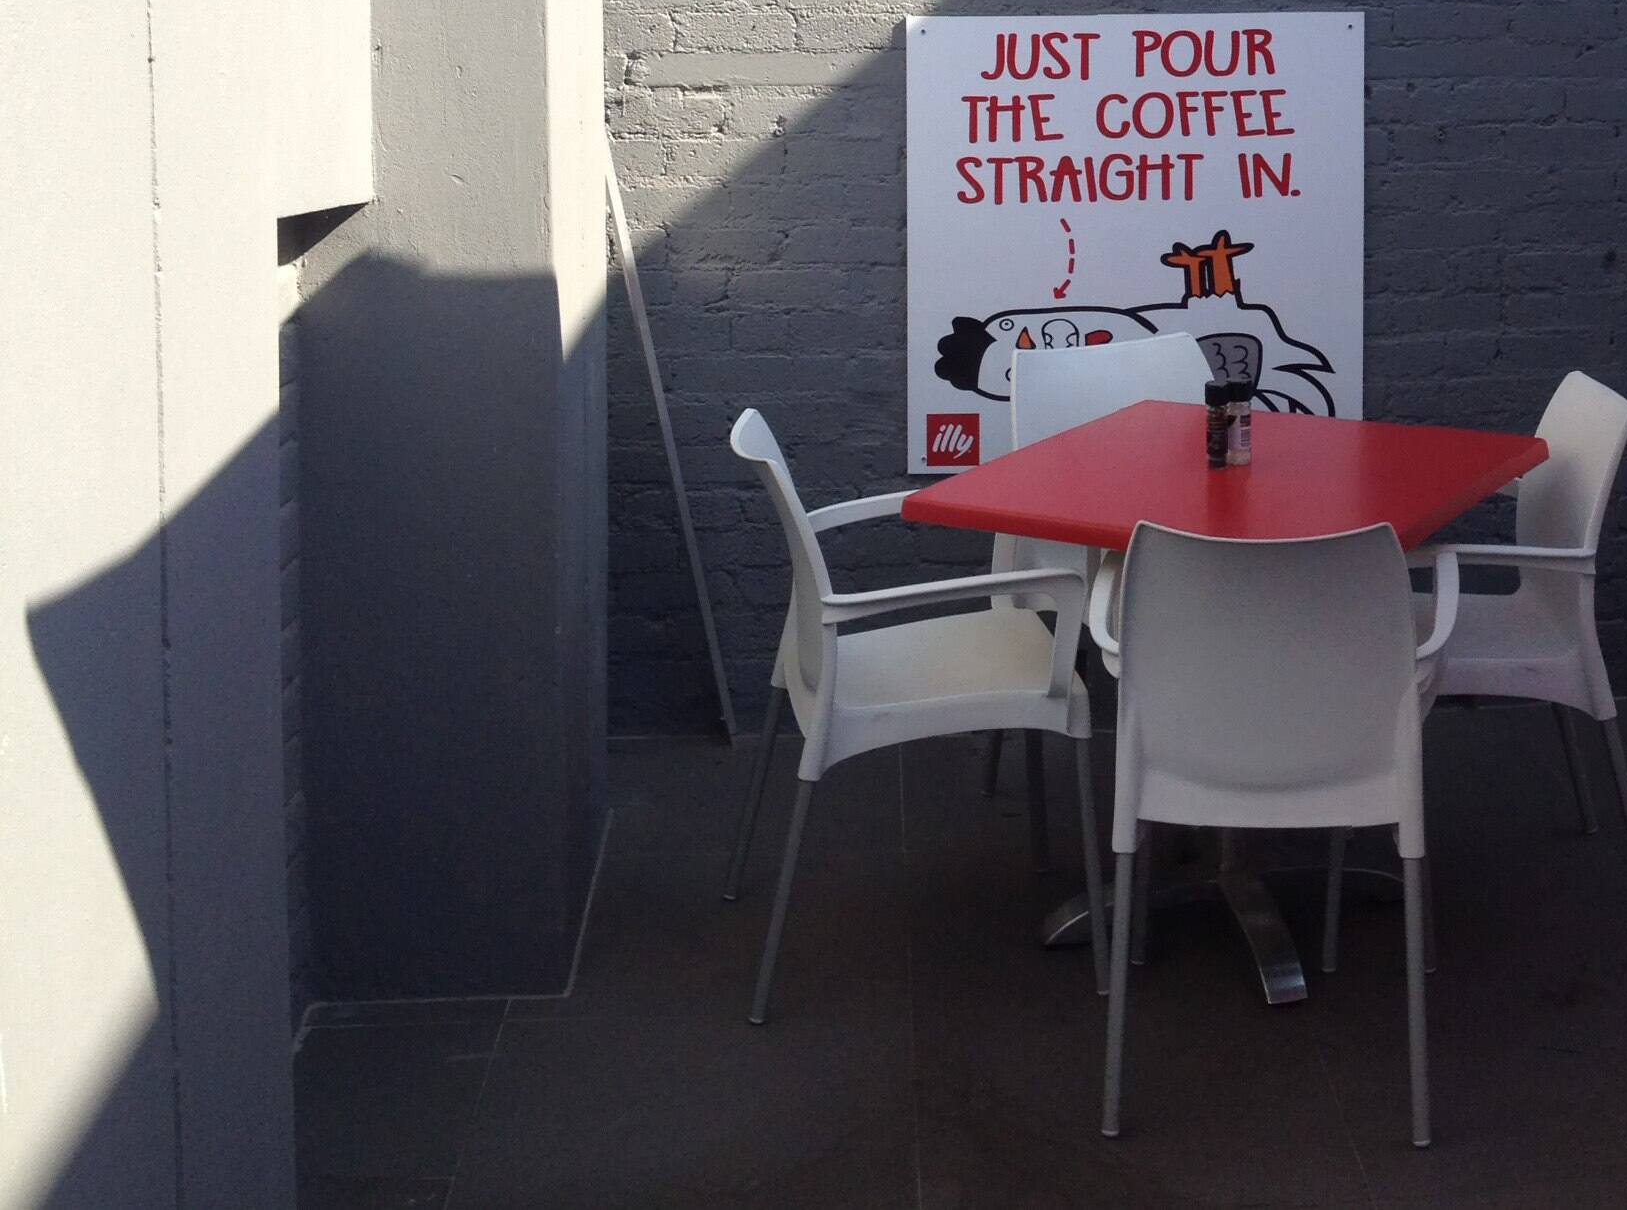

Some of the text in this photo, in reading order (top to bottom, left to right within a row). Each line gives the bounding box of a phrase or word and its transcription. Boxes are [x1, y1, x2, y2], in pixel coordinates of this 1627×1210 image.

[980, 28, 1276, 81] JUST POUR
[961, 88, 1295, 144] THE COFFEE
[955, 152, 1302, 205] STRAIGHT IN.
[931, 422, 975, 460] illy
